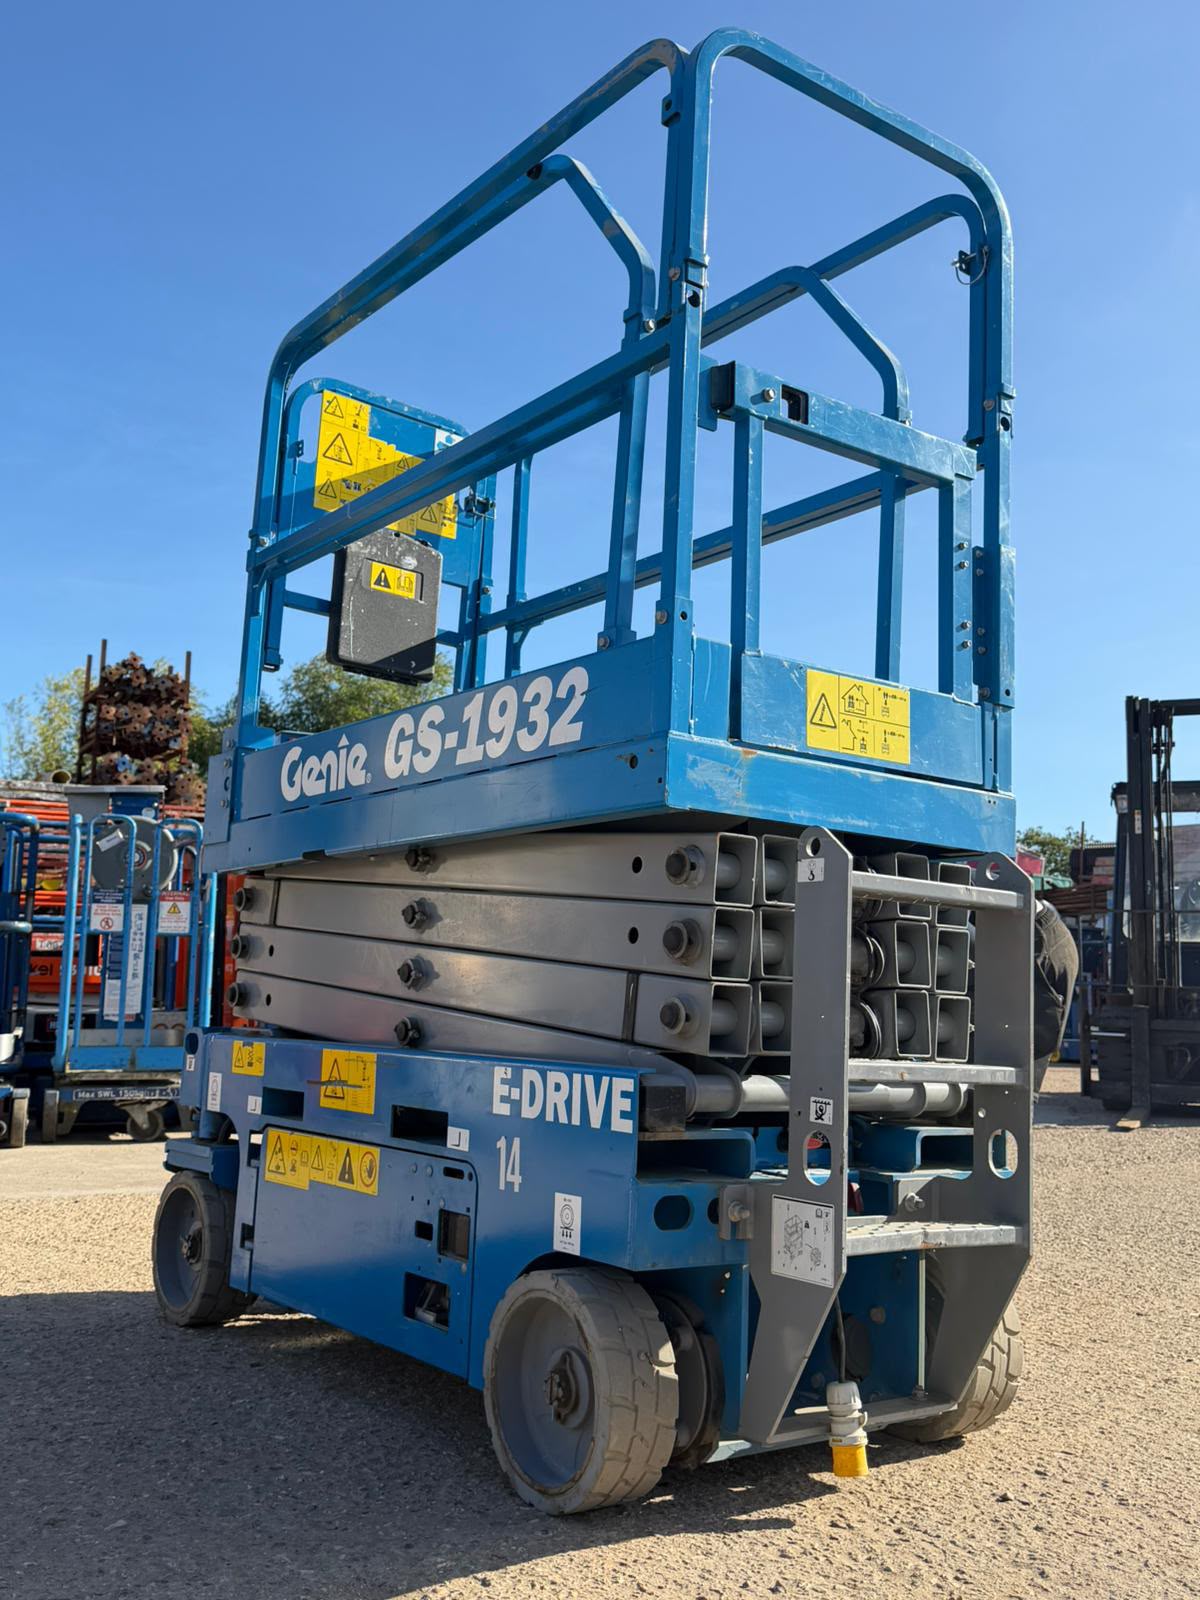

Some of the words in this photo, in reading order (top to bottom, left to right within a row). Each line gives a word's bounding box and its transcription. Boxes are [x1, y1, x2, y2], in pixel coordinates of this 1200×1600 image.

[281, 734, 368, 802] Genie
[384, 666, 589, 780] GS-1932
[97, 1090, 116, 1098] SWL
[492, 1066, 634, 1134] E-DRIVE
[496, 1135, 522, 1193] 14
